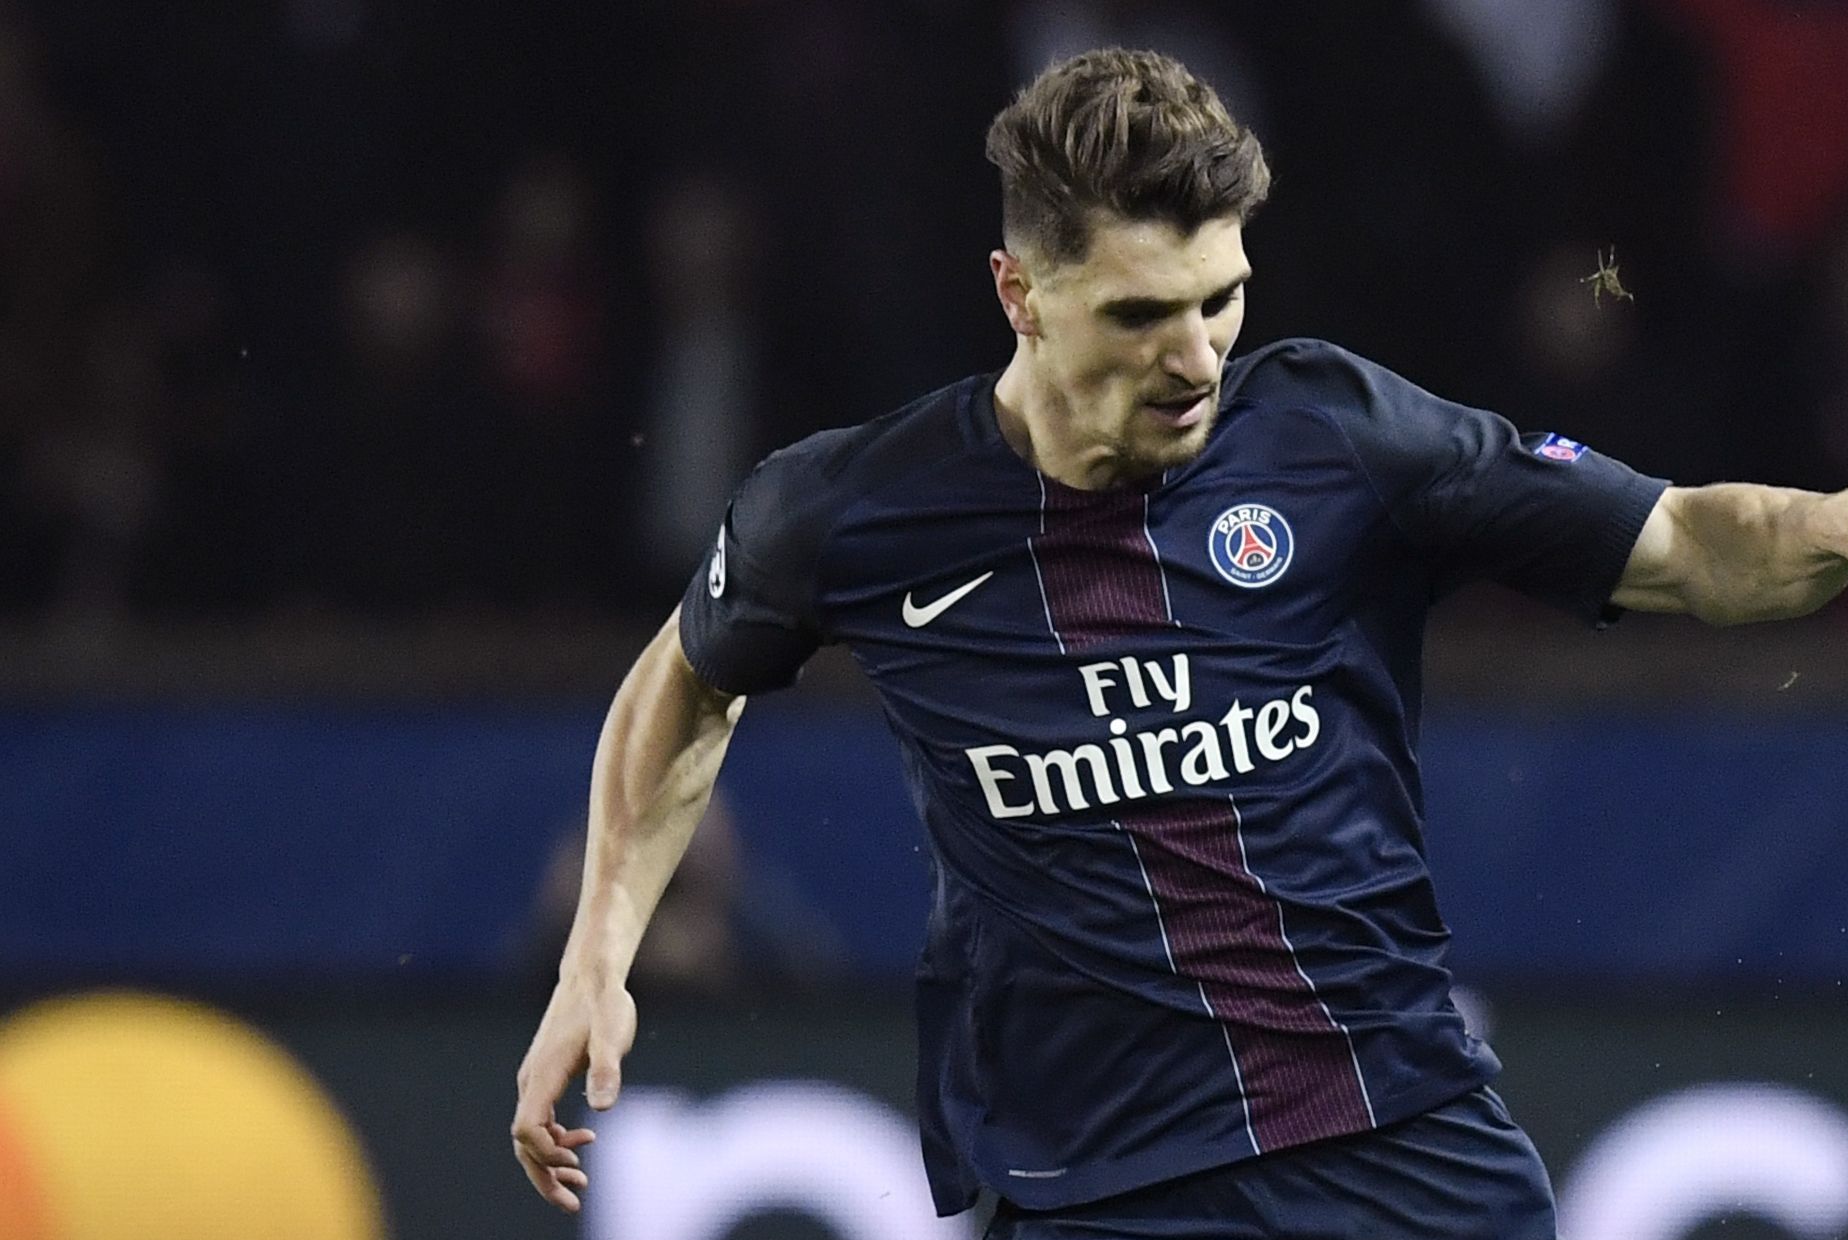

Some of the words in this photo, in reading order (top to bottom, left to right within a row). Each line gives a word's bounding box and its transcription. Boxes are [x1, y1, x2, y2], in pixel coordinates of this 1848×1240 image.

[1217, 508, 1272, 535] PARIS
[1078, 652, 1192, 718] Fly
[965, 684, 1321, 820] Emirates
